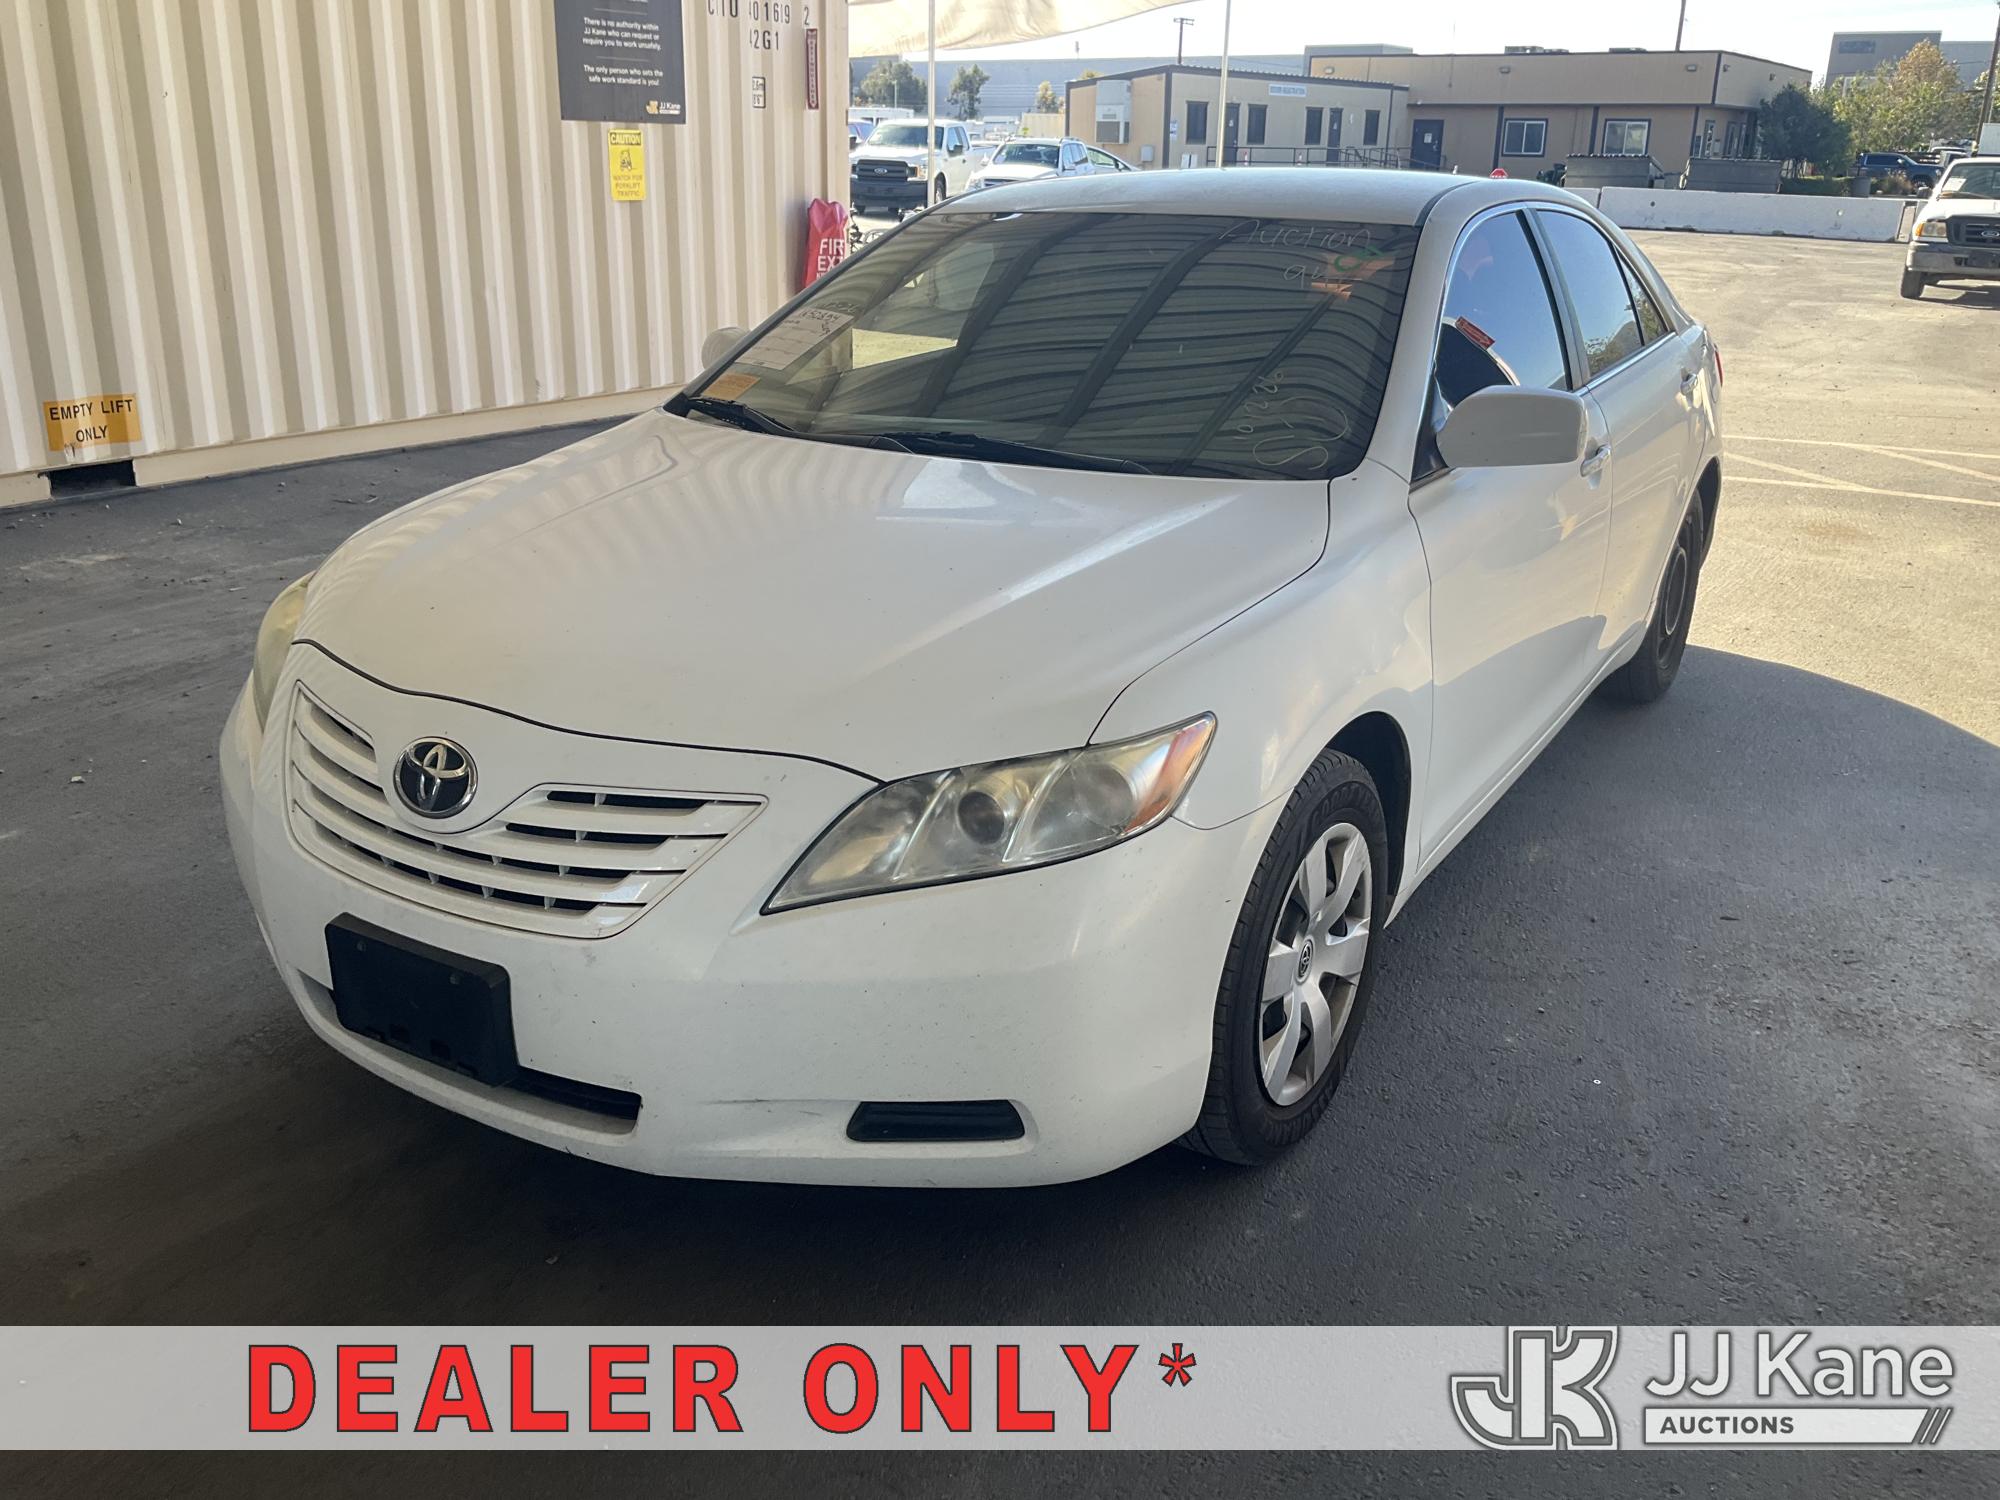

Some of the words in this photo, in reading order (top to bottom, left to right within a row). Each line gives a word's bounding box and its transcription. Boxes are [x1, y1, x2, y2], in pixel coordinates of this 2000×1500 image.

[804, 6, 809, 25] 2
[584, 17, 600, 26] There
[616, 21, 641, 31] authority
[642, 23, 659, 31] within
[583, 37, 603, 45] require
[592, 28, 606, 36] Kane
[607, 29, 619, 37] who
[632, 33, 652, 41] request
[584, 64, 594, 72] The
[596, 66, 608, 74] only
[609, 67, 628, 75] person
[654, 69, 663, 77] the
[617, 77, 641, 85] standard
[610, 133, 641, 145] CAUTION
[1218, 219, 1371, 249] Auction
[49, 402, 93, 421] EMPTY
[101, 399, 133, 414] LIFT
[76, 425, 108, 442] ONLY
